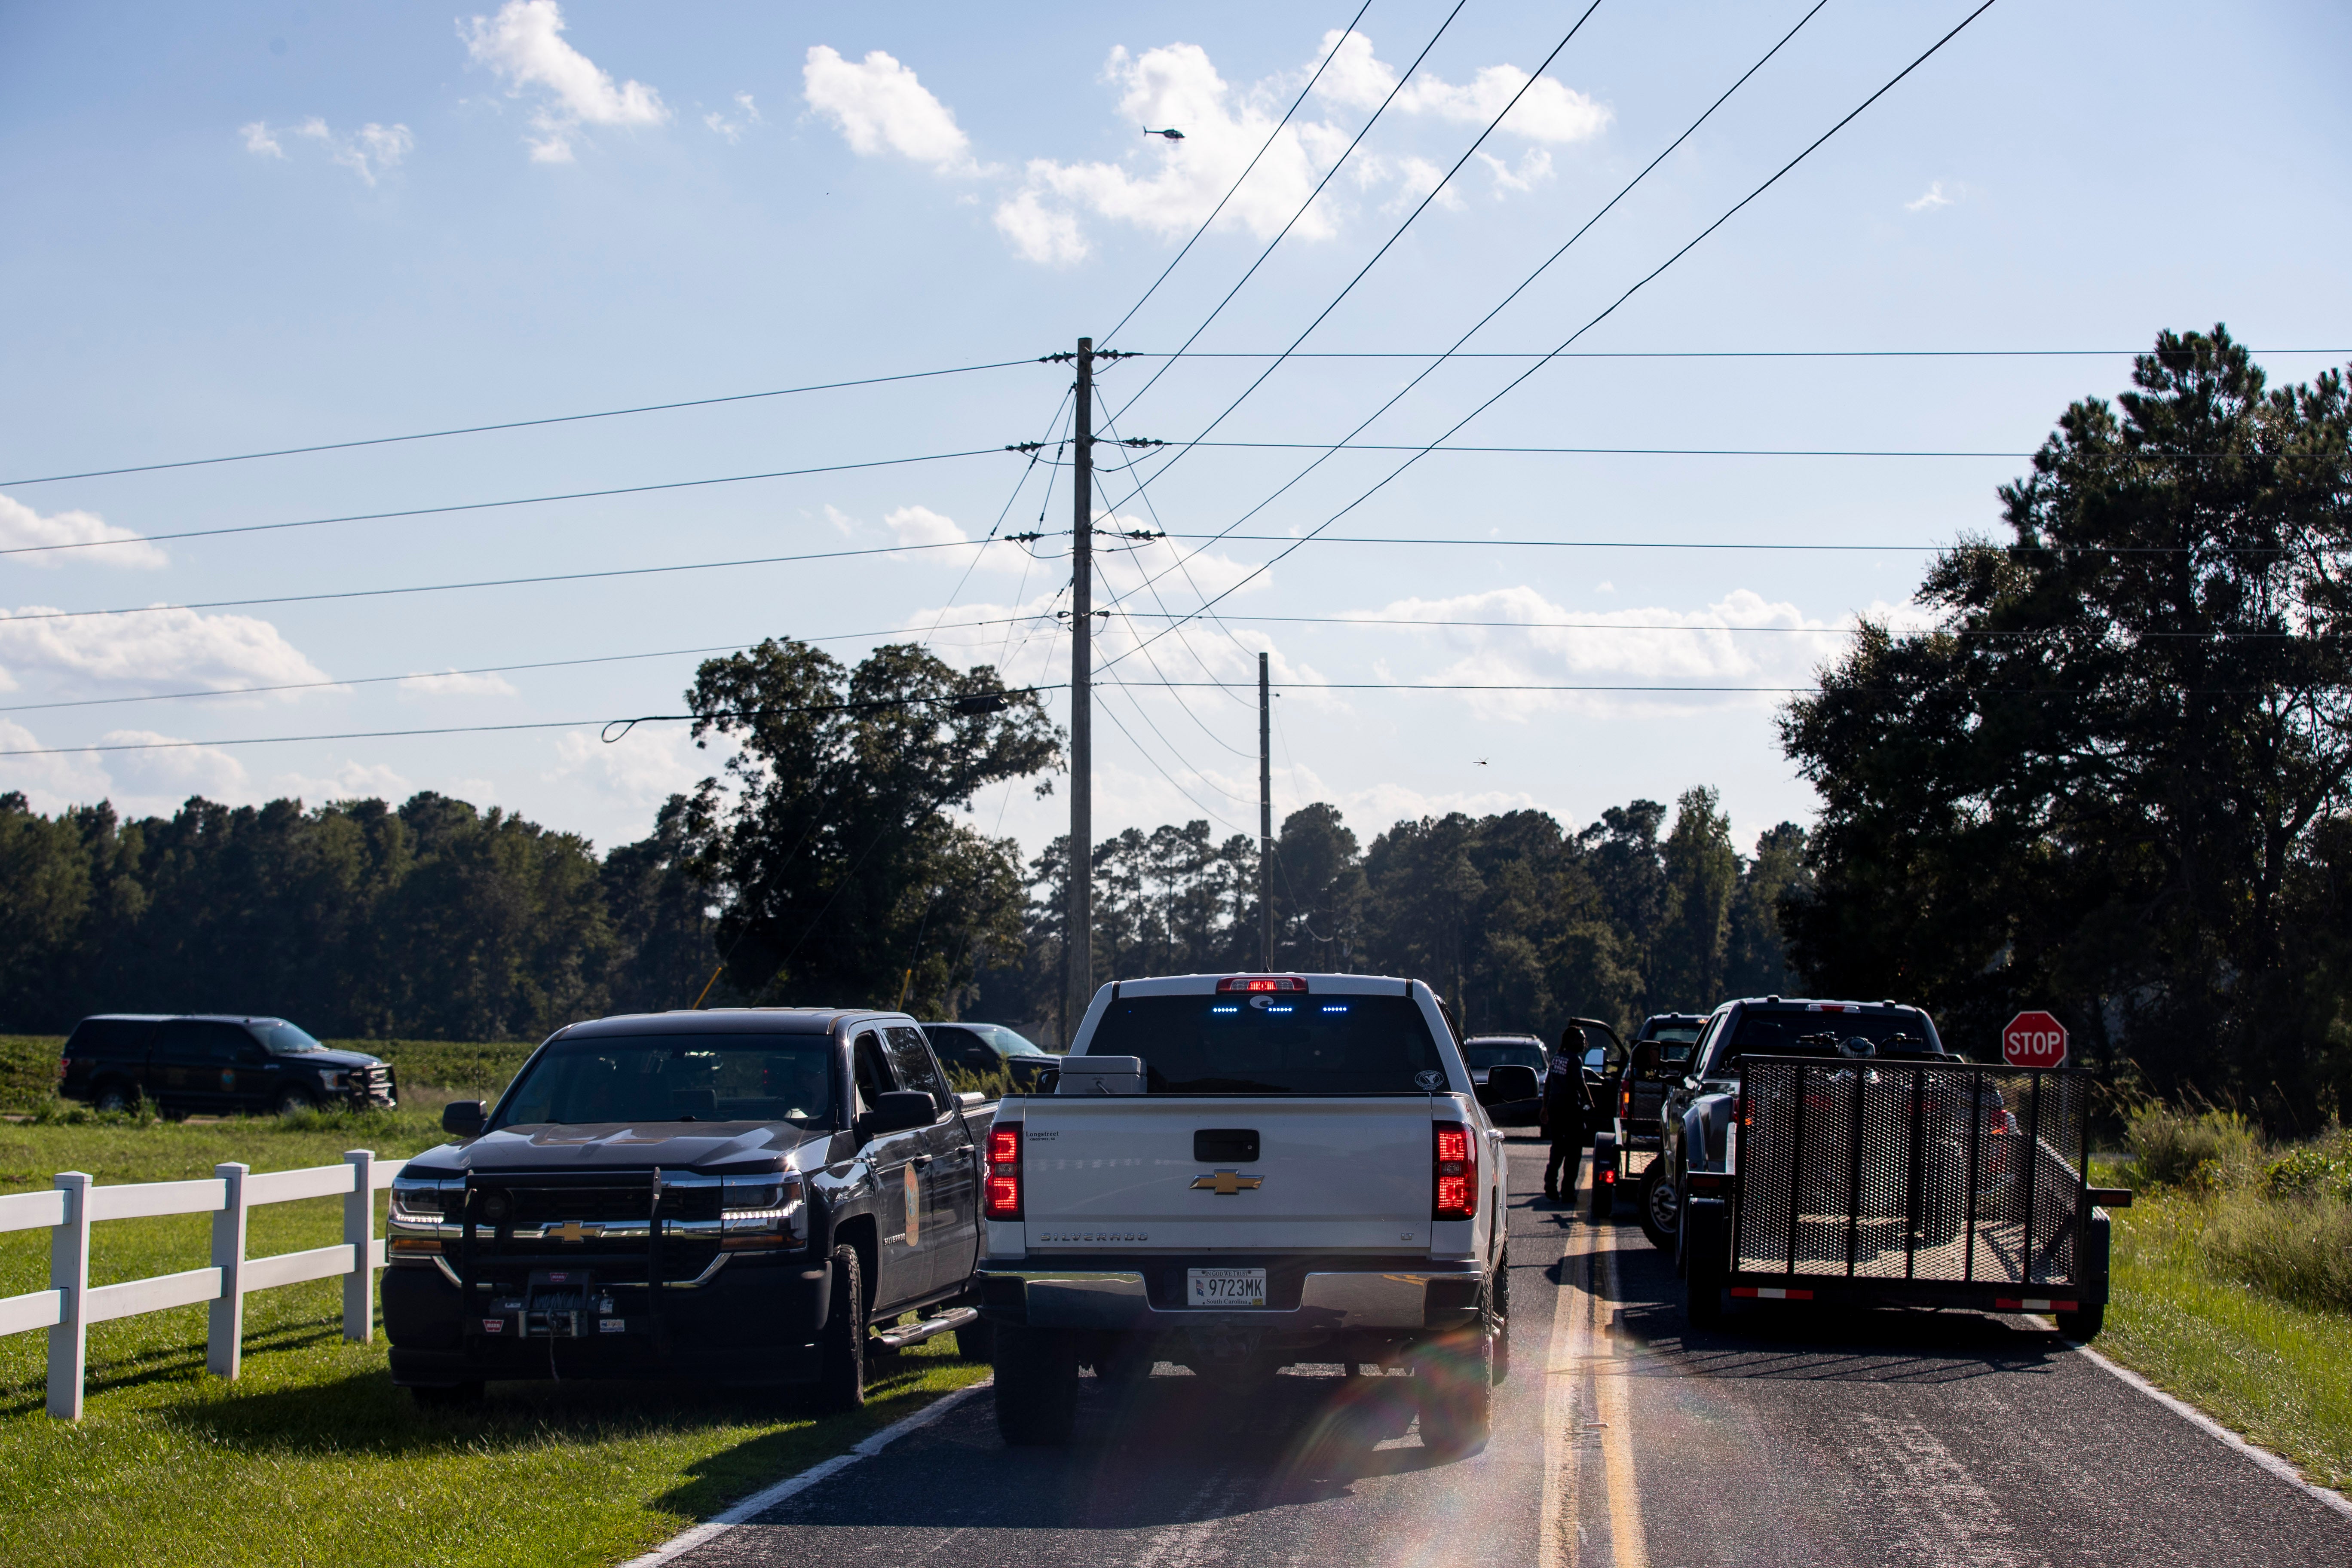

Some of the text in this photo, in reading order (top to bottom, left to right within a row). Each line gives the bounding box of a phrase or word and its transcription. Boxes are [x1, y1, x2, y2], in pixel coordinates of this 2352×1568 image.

[2008, 1032, 2061, 1055] STOP
[883, 1233, 906, 1246] SILVERADO
[1041, 1232, 1148, 1241] SILVERADO
[1209, 1279, 1262, 1296] 9723MK
